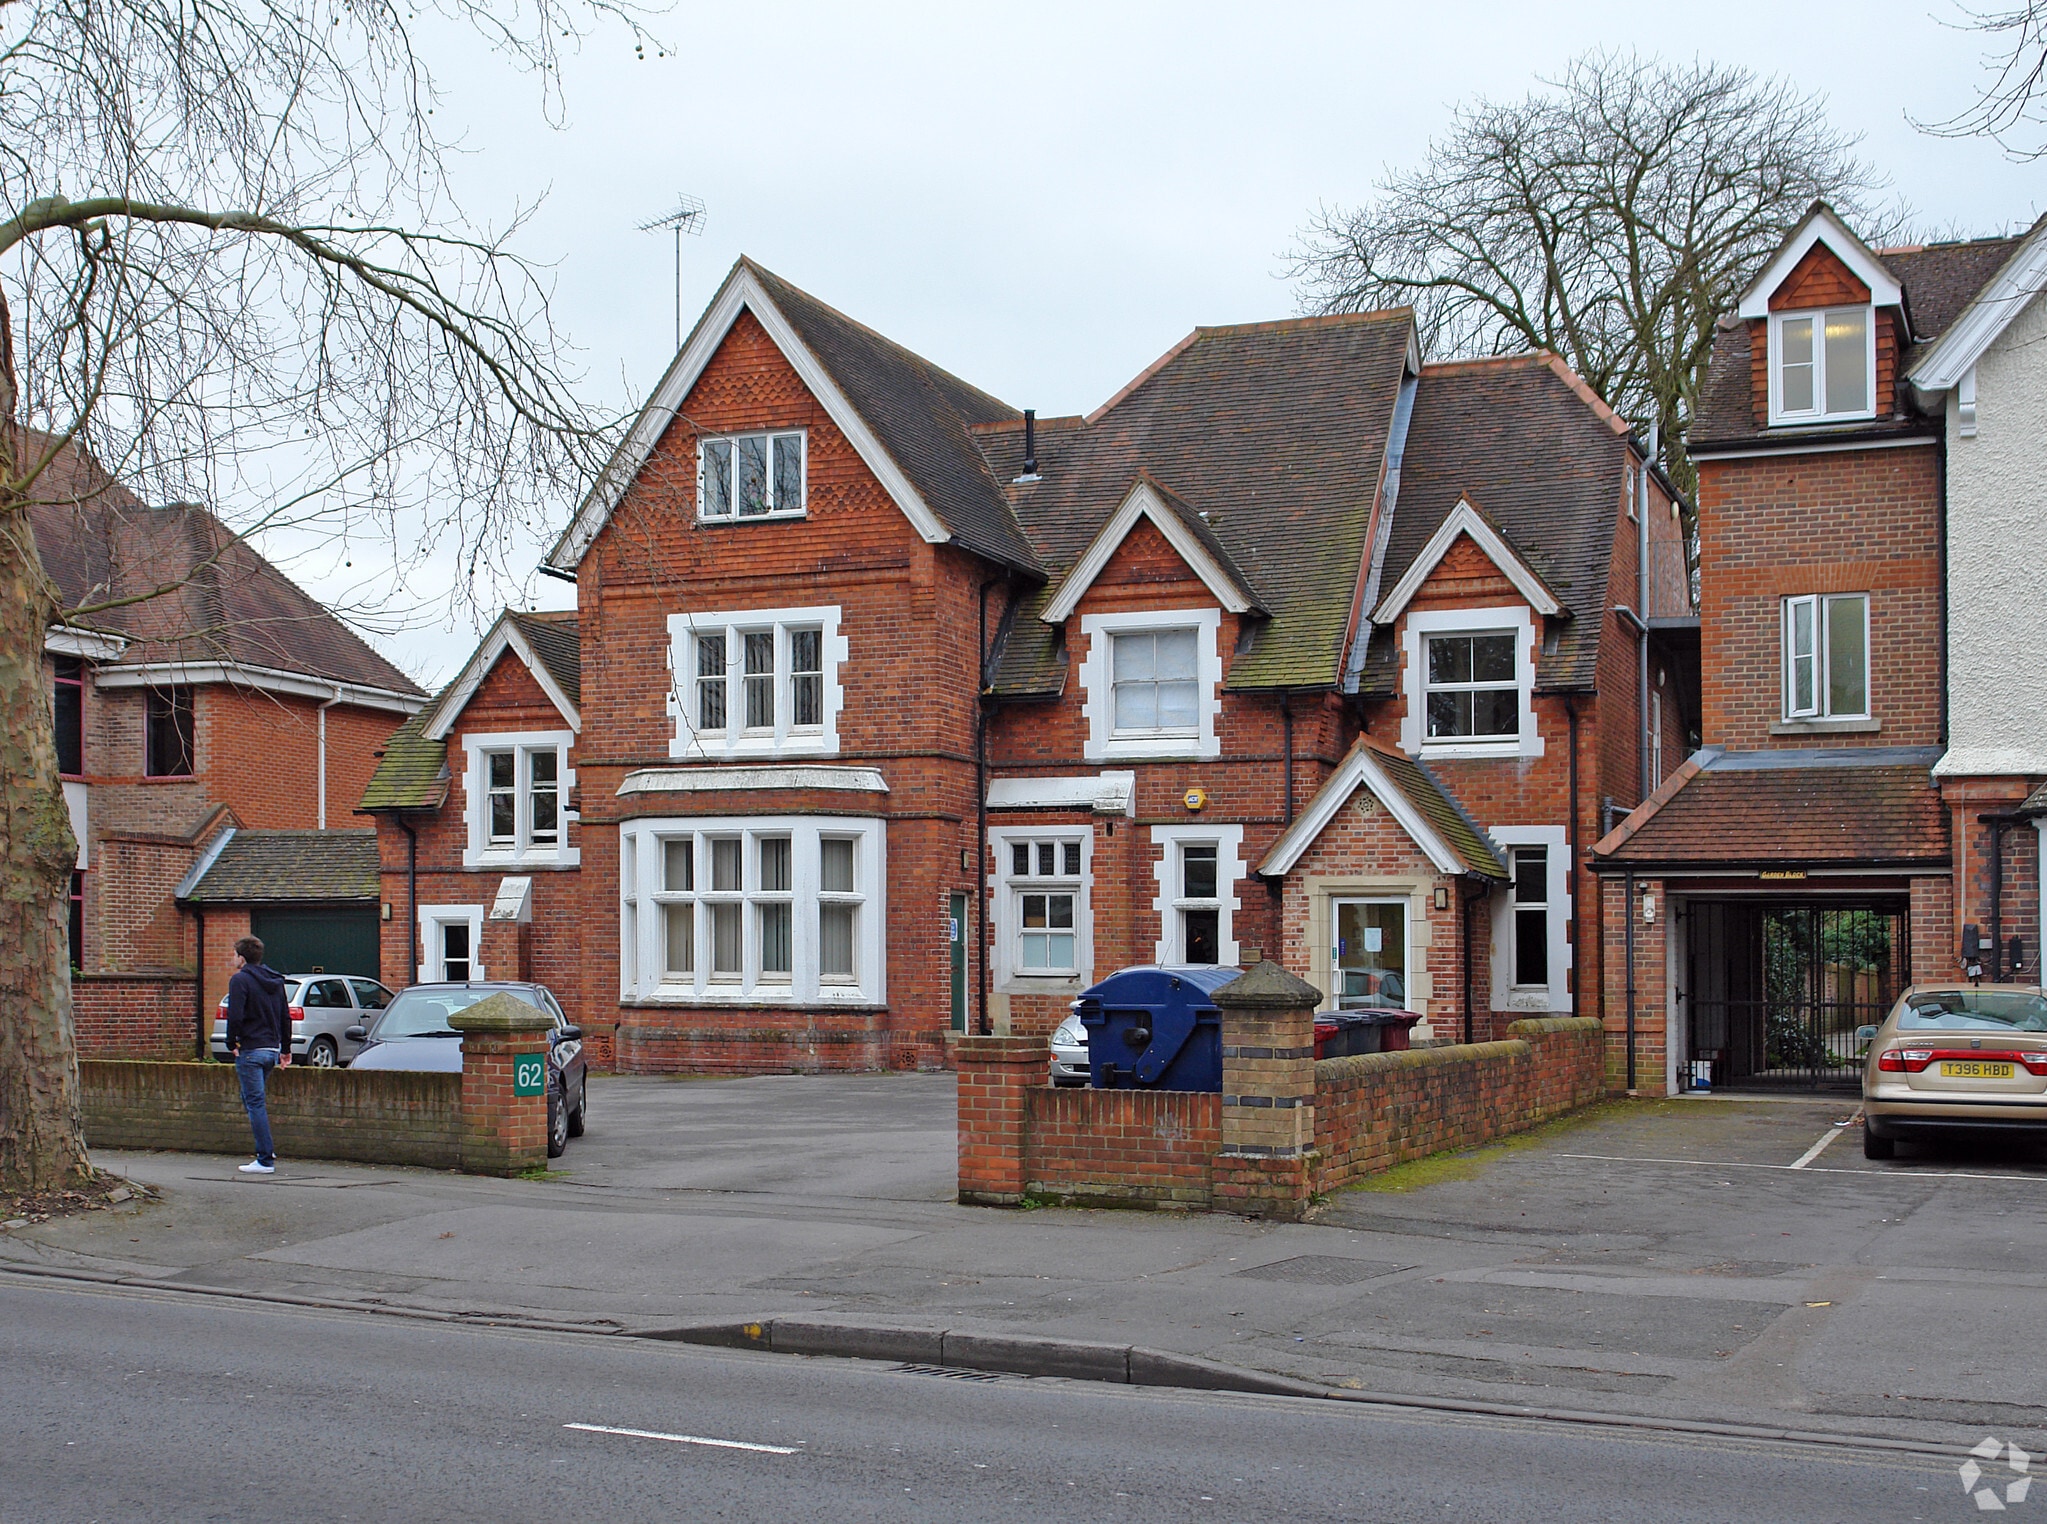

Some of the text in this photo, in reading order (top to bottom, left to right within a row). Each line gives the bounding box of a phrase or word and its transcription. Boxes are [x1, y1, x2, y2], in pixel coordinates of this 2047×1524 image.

[518, 1063, 541, 1087] 62
[1946, 1063, 2009, 1076] T396 HBD
